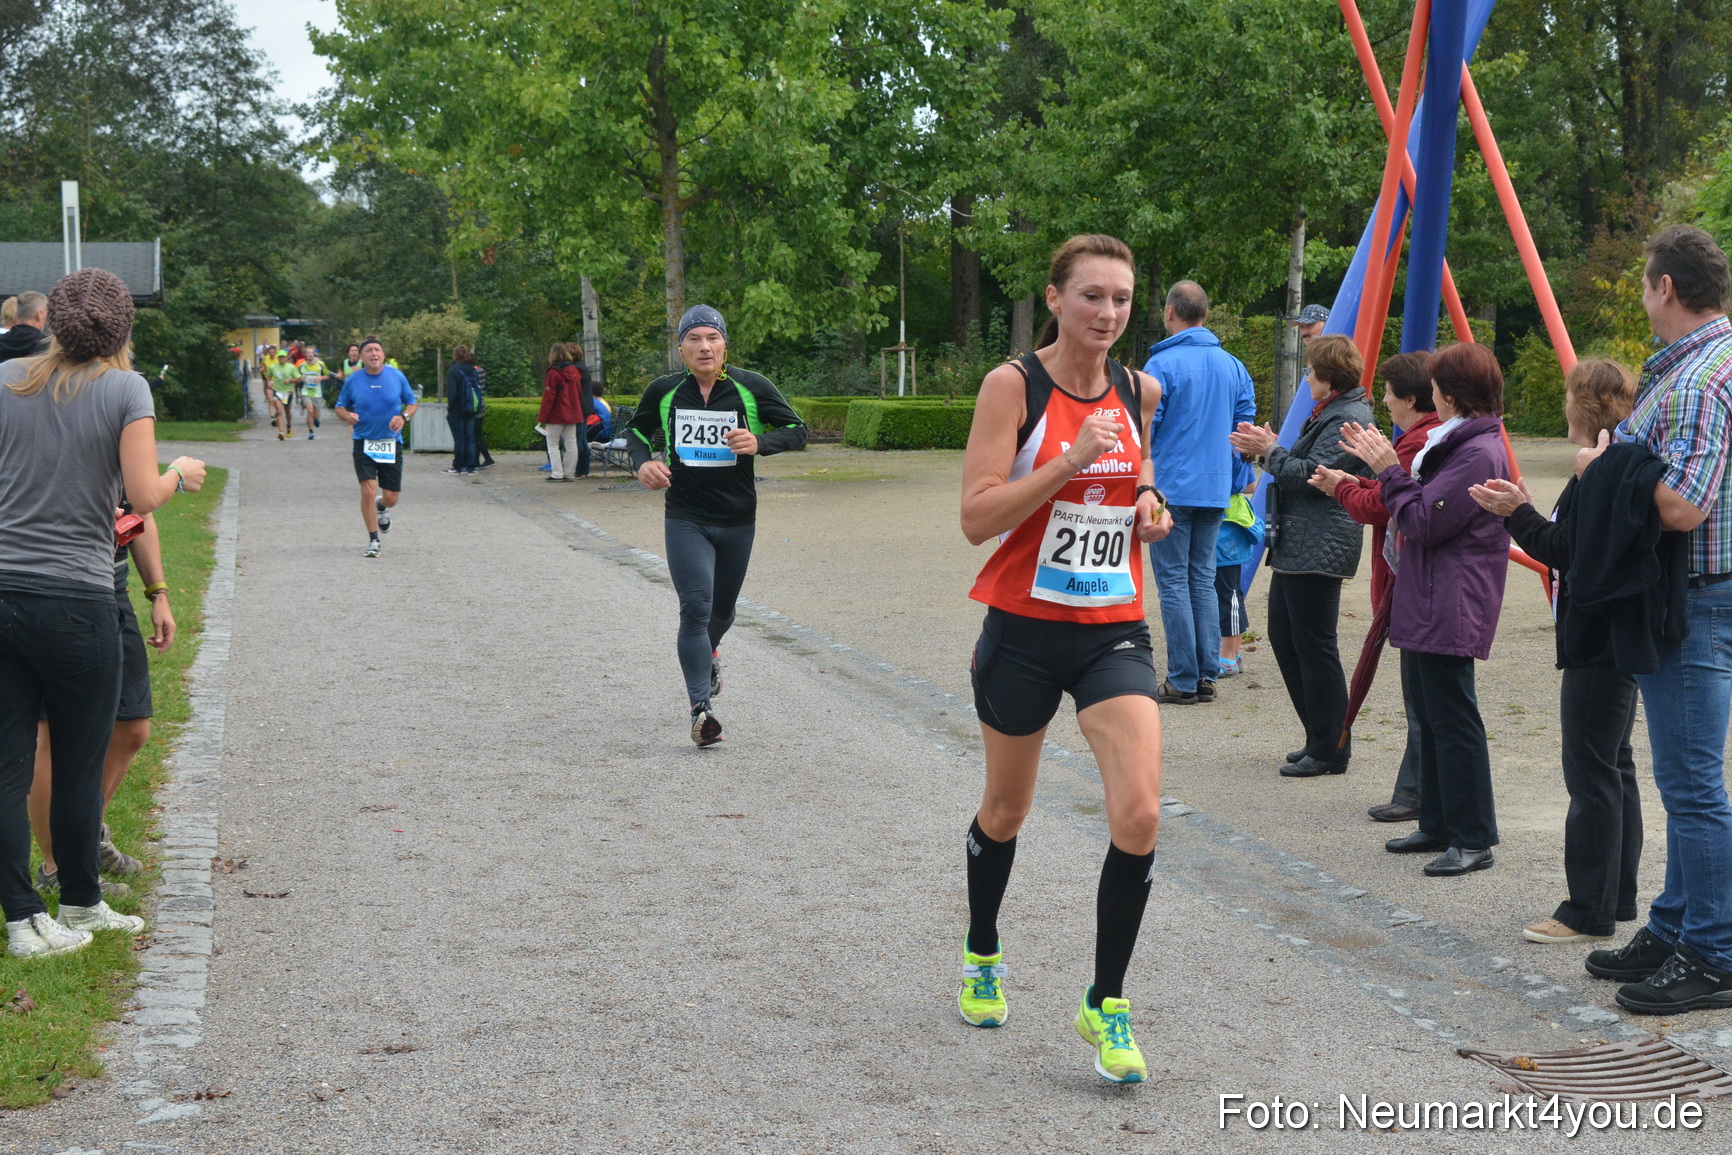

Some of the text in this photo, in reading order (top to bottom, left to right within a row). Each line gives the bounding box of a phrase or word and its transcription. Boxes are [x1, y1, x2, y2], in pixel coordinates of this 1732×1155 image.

[368, 441, 392, 452] 2501
[694, 450, 717, 459] Klaus
[1053, 509, 1123, 526] PARTL Neumarkt
[1051, 527, 1124, 568] 2190
[1065, 577, 1109, 595] Angela
